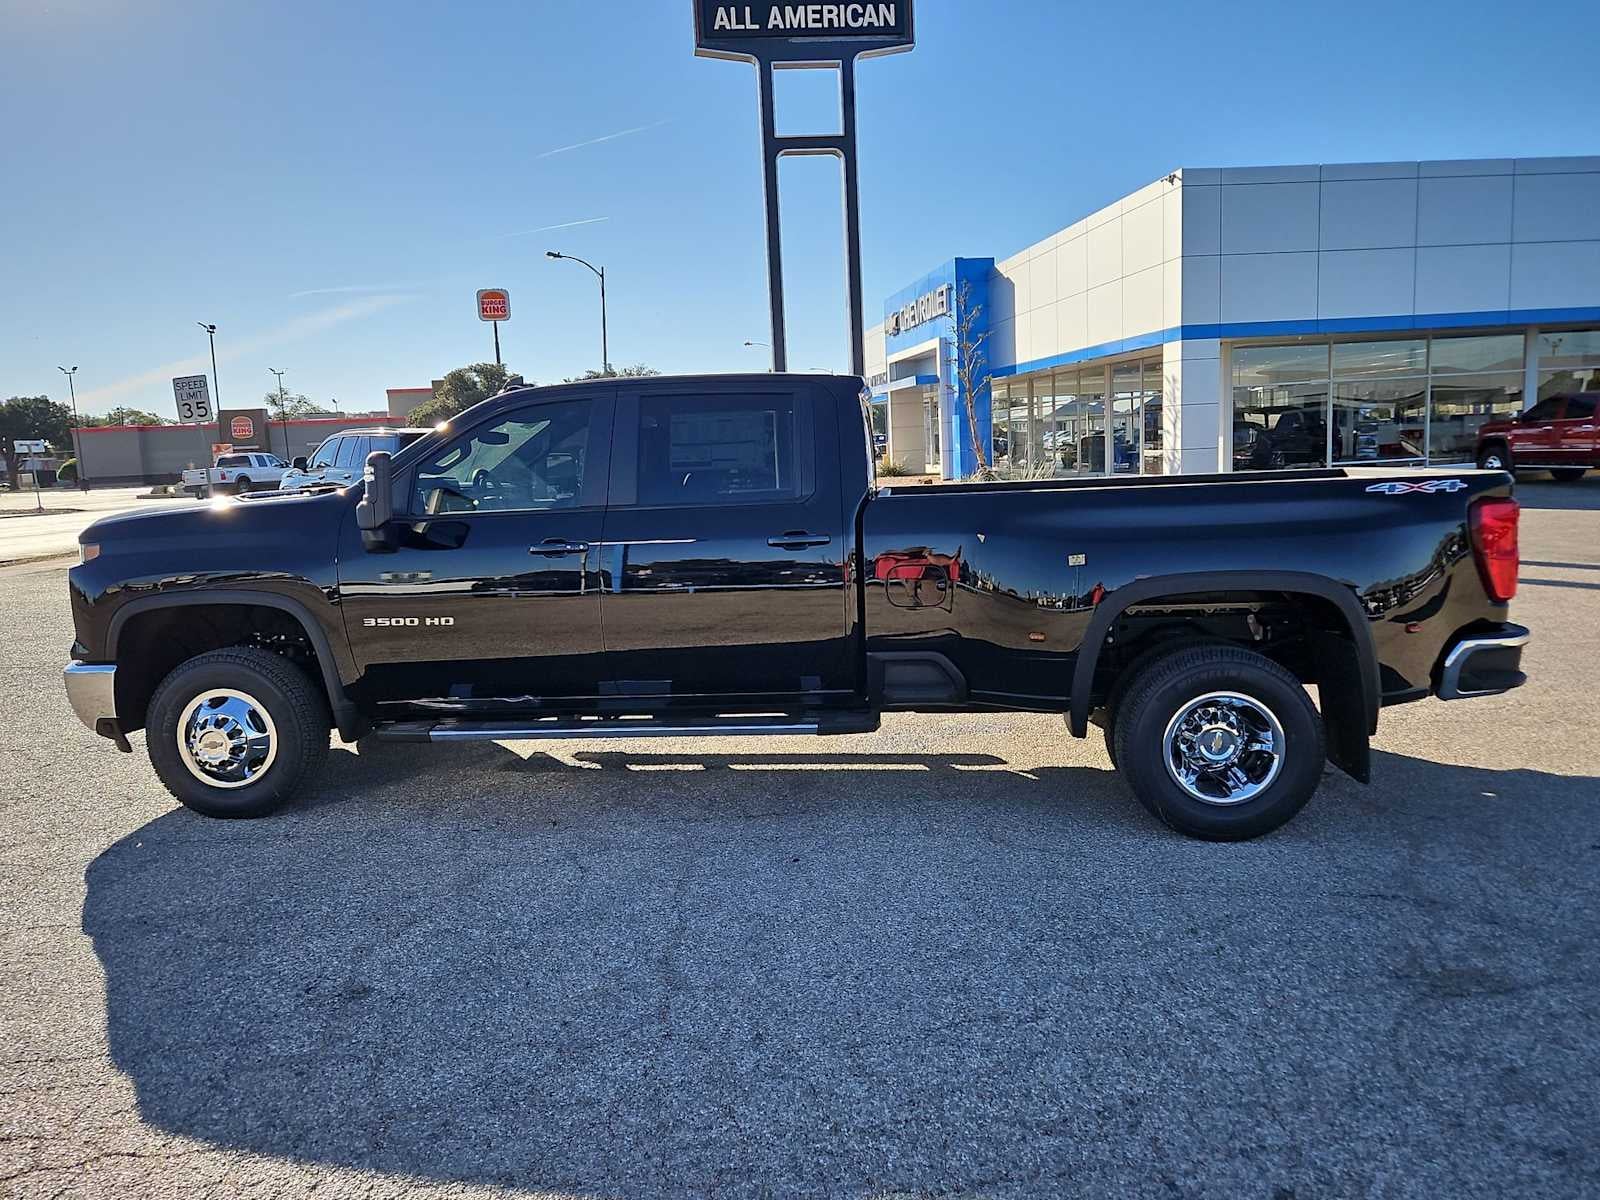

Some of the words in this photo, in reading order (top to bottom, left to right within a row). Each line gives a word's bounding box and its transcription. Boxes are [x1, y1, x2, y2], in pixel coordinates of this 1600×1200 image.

[714, 6, 760, 30] ALL
[767, 4, 896, 29] AMERICAN
[481, 305, 507, 314] KING
[175, 380, 206, 391] SPEED
[180, 390, 203, 401] LIMIT
[182, 401, 208, 419] 35
[363, 617, 419, 627] 3500
[425, 616, 455, 626] HD
